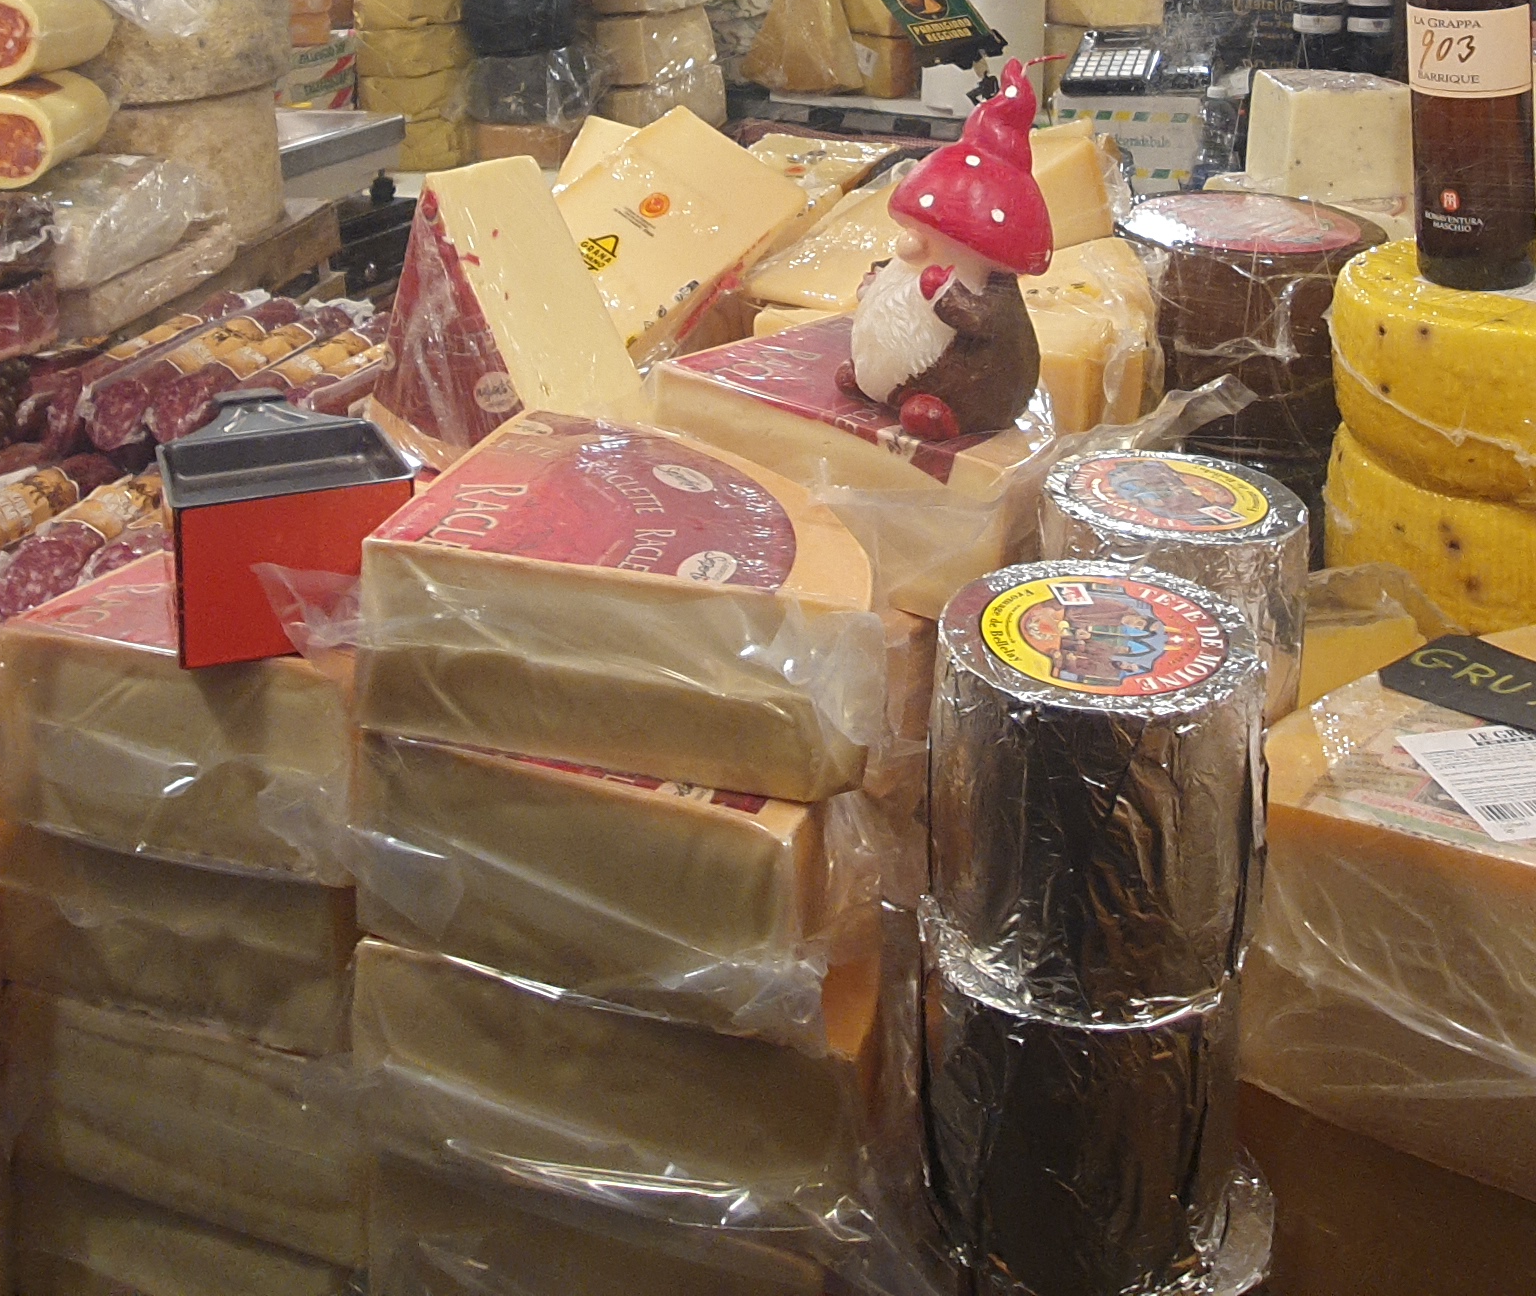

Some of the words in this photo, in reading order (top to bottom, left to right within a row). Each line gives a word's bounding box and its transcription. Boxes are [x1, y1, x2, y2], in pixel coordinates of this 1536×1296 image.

[1427, 17, 1482, 30] GRAPPA
[1419, 29, 1476, 70] 903
[1417, 68, 1481, 85] BARRIQUE
[580, 240, 613, 265] GRANA
[1135, 649, 1221, 692] MOINE
